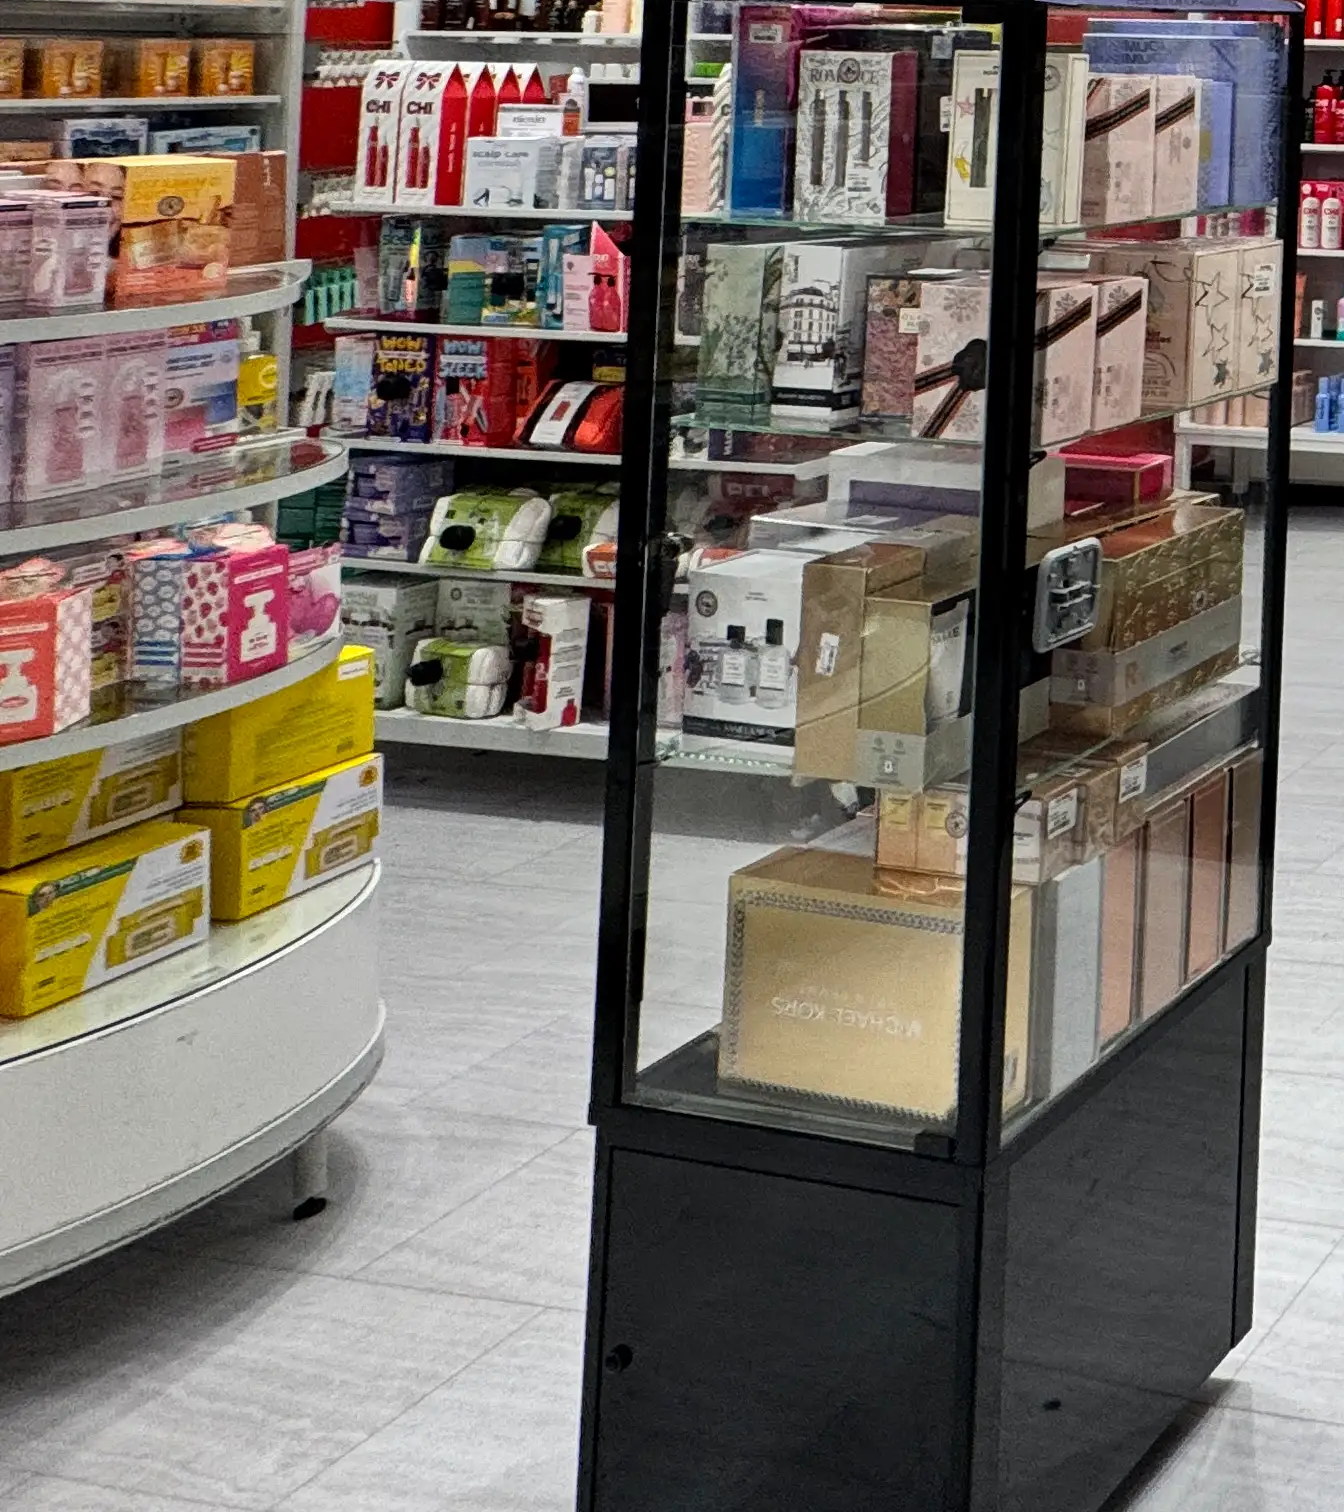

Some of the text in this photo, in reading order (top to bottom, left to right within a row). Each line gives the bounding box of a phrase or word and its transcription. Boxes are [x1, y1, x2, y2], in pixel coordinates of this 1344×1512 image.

[809, 69, 879, 85] ROMCE
[366, 99, 391, 114] CHI
[407, 101, 434, 115] CHI
[771, 996, 828, 1024] KORS
